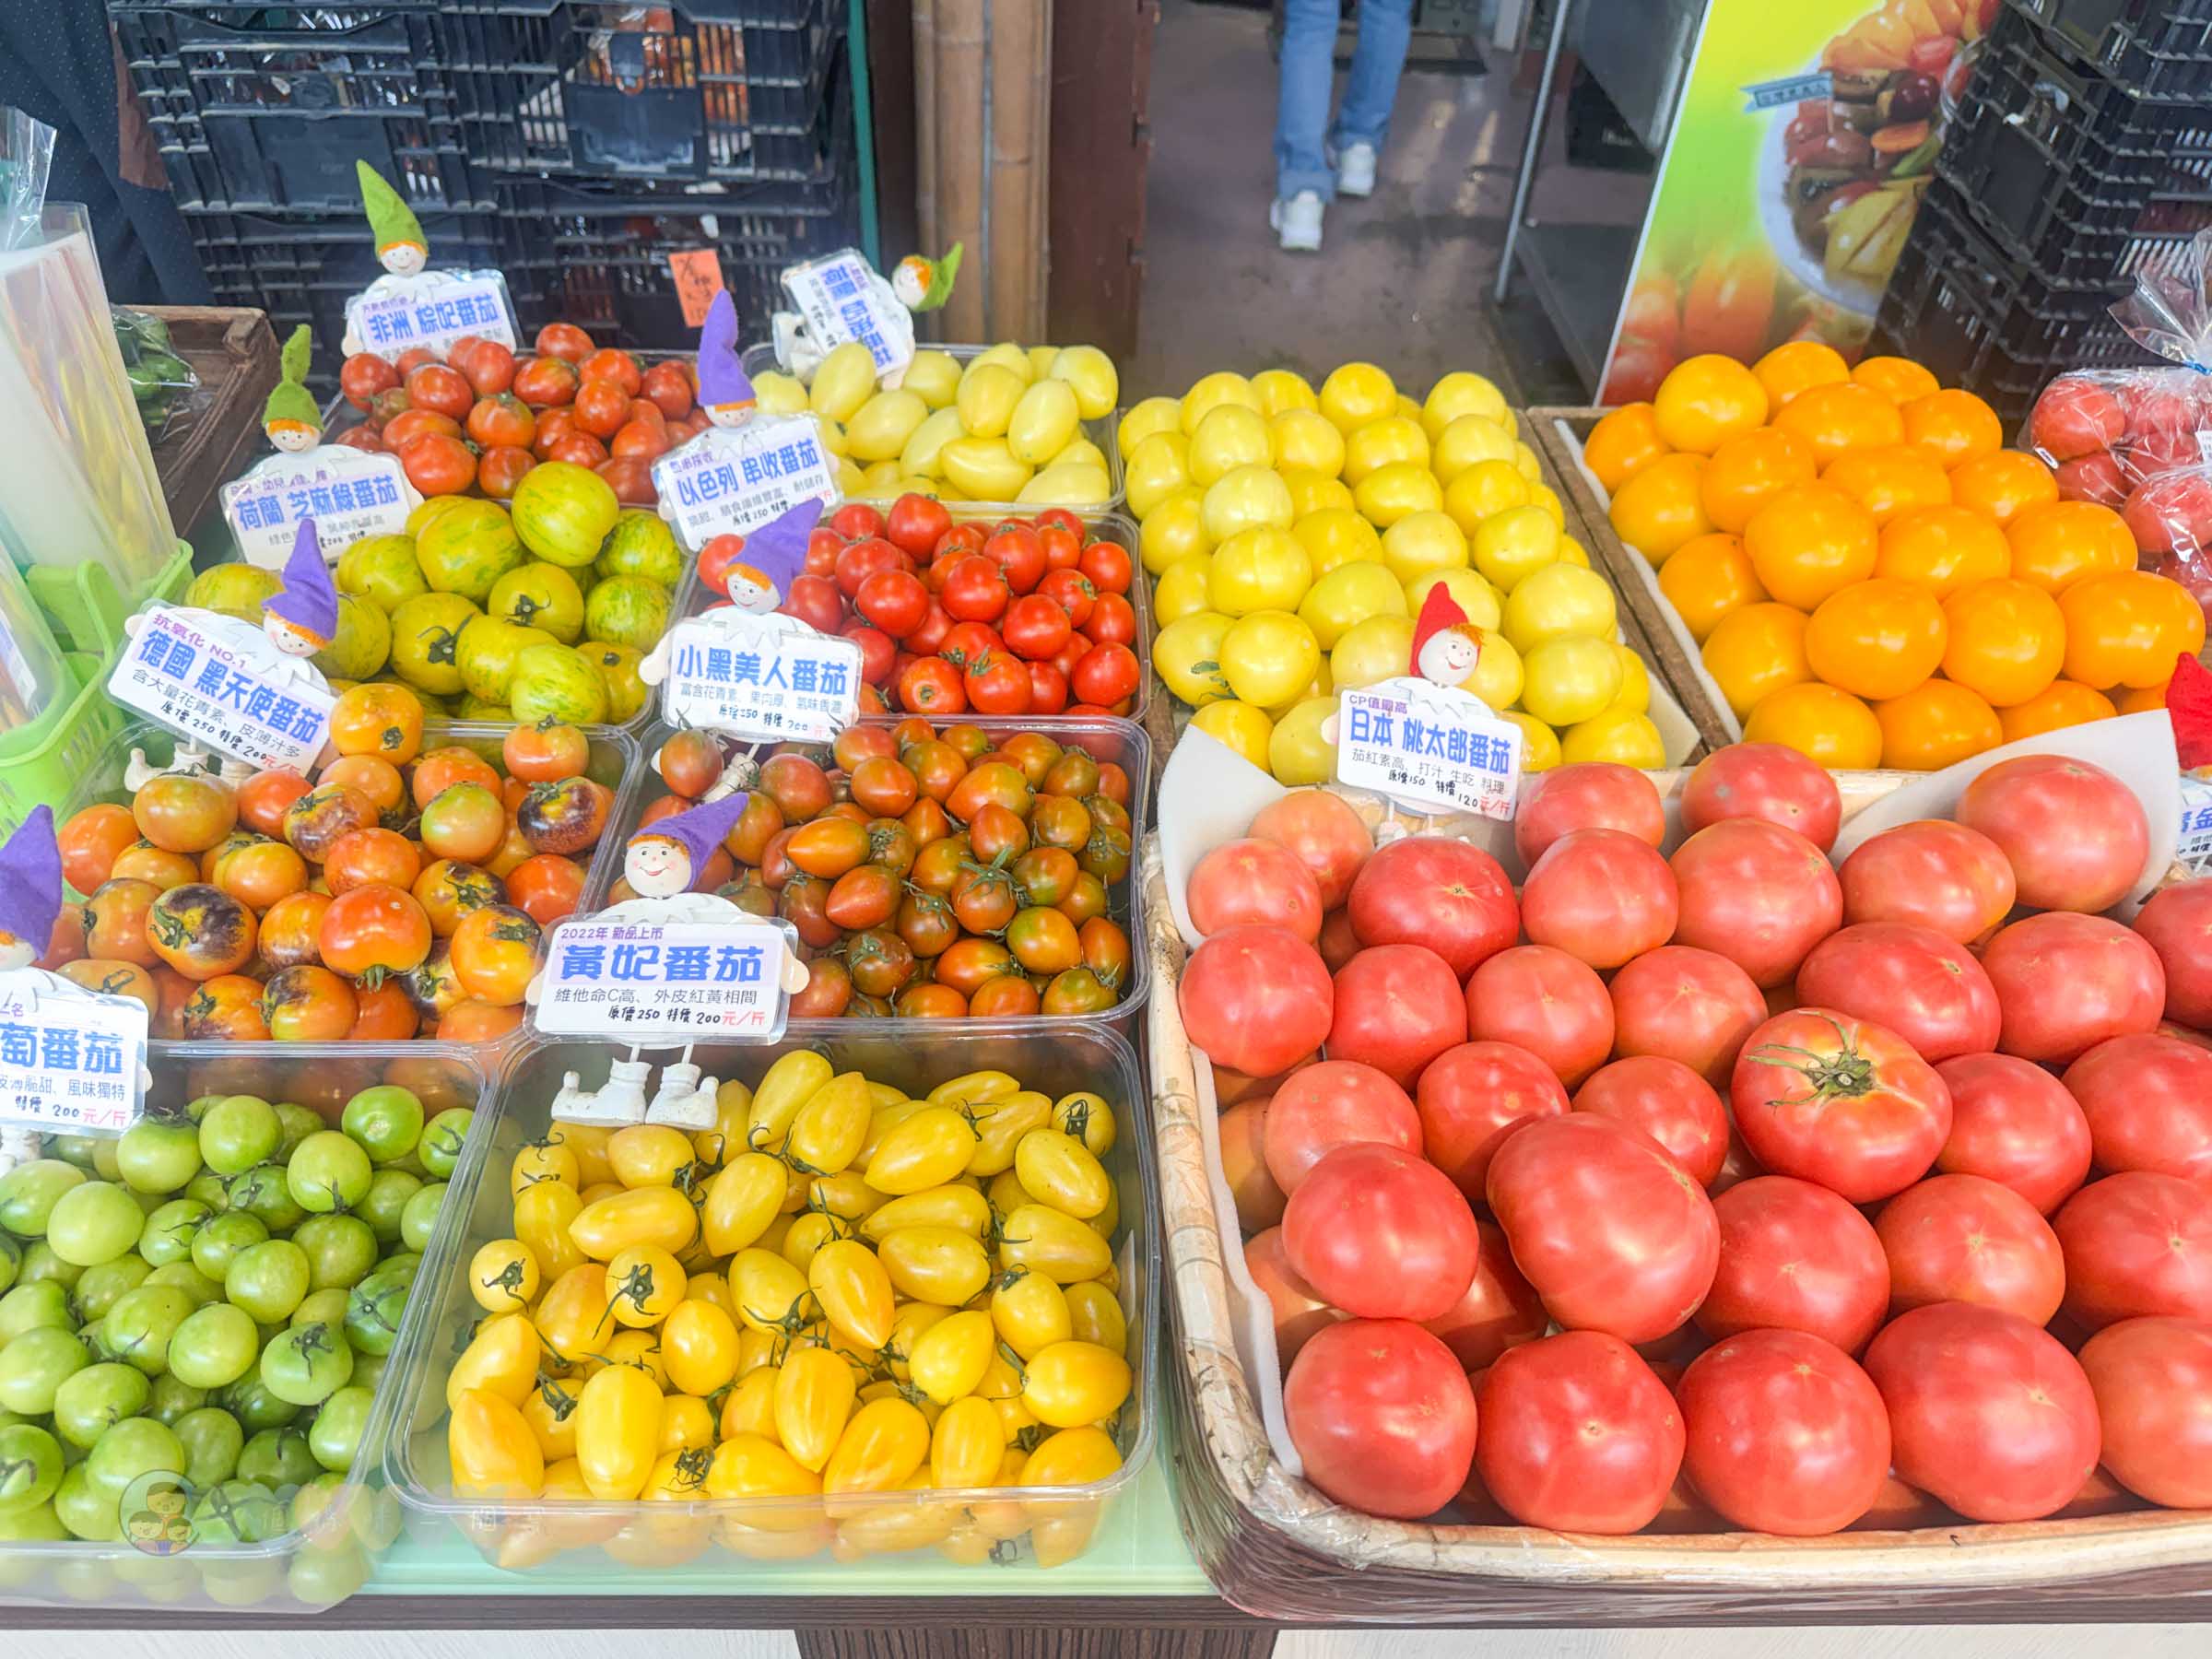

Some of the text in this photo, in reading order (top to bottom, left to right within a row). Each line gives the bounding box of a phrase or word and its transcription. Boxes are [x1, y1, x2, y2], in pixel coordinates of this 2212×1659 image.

[368, 310, 414, 343] 非洲
[677, 439, 820, 506] 以色列 串收番茄
[235, 494, 285, 531] 荷蘭
[287, 474, 399, 520] 芝麻綠番茄
[152, 613, 248, 669] 抗氧化 NO.1
[138, 629, 325, 744] 德國 黑天使番茄
[677, 644, 848, 696] 小黑美人番茄
[239, 723, 302, 759] 皮薄汁多
[1350, 706, 1511, 775] 日本 桃太郎番茄
[560, 926, 664, 940] 2022年 新品上市
[560, 945, 764, 982] 黃妃番茄
[654, 989, 758, 1005] 外皮紅黃相間
[0, 1021, 124, 1074] 萄番茄
[67, 1078, 126, 1100] 風味獨特
